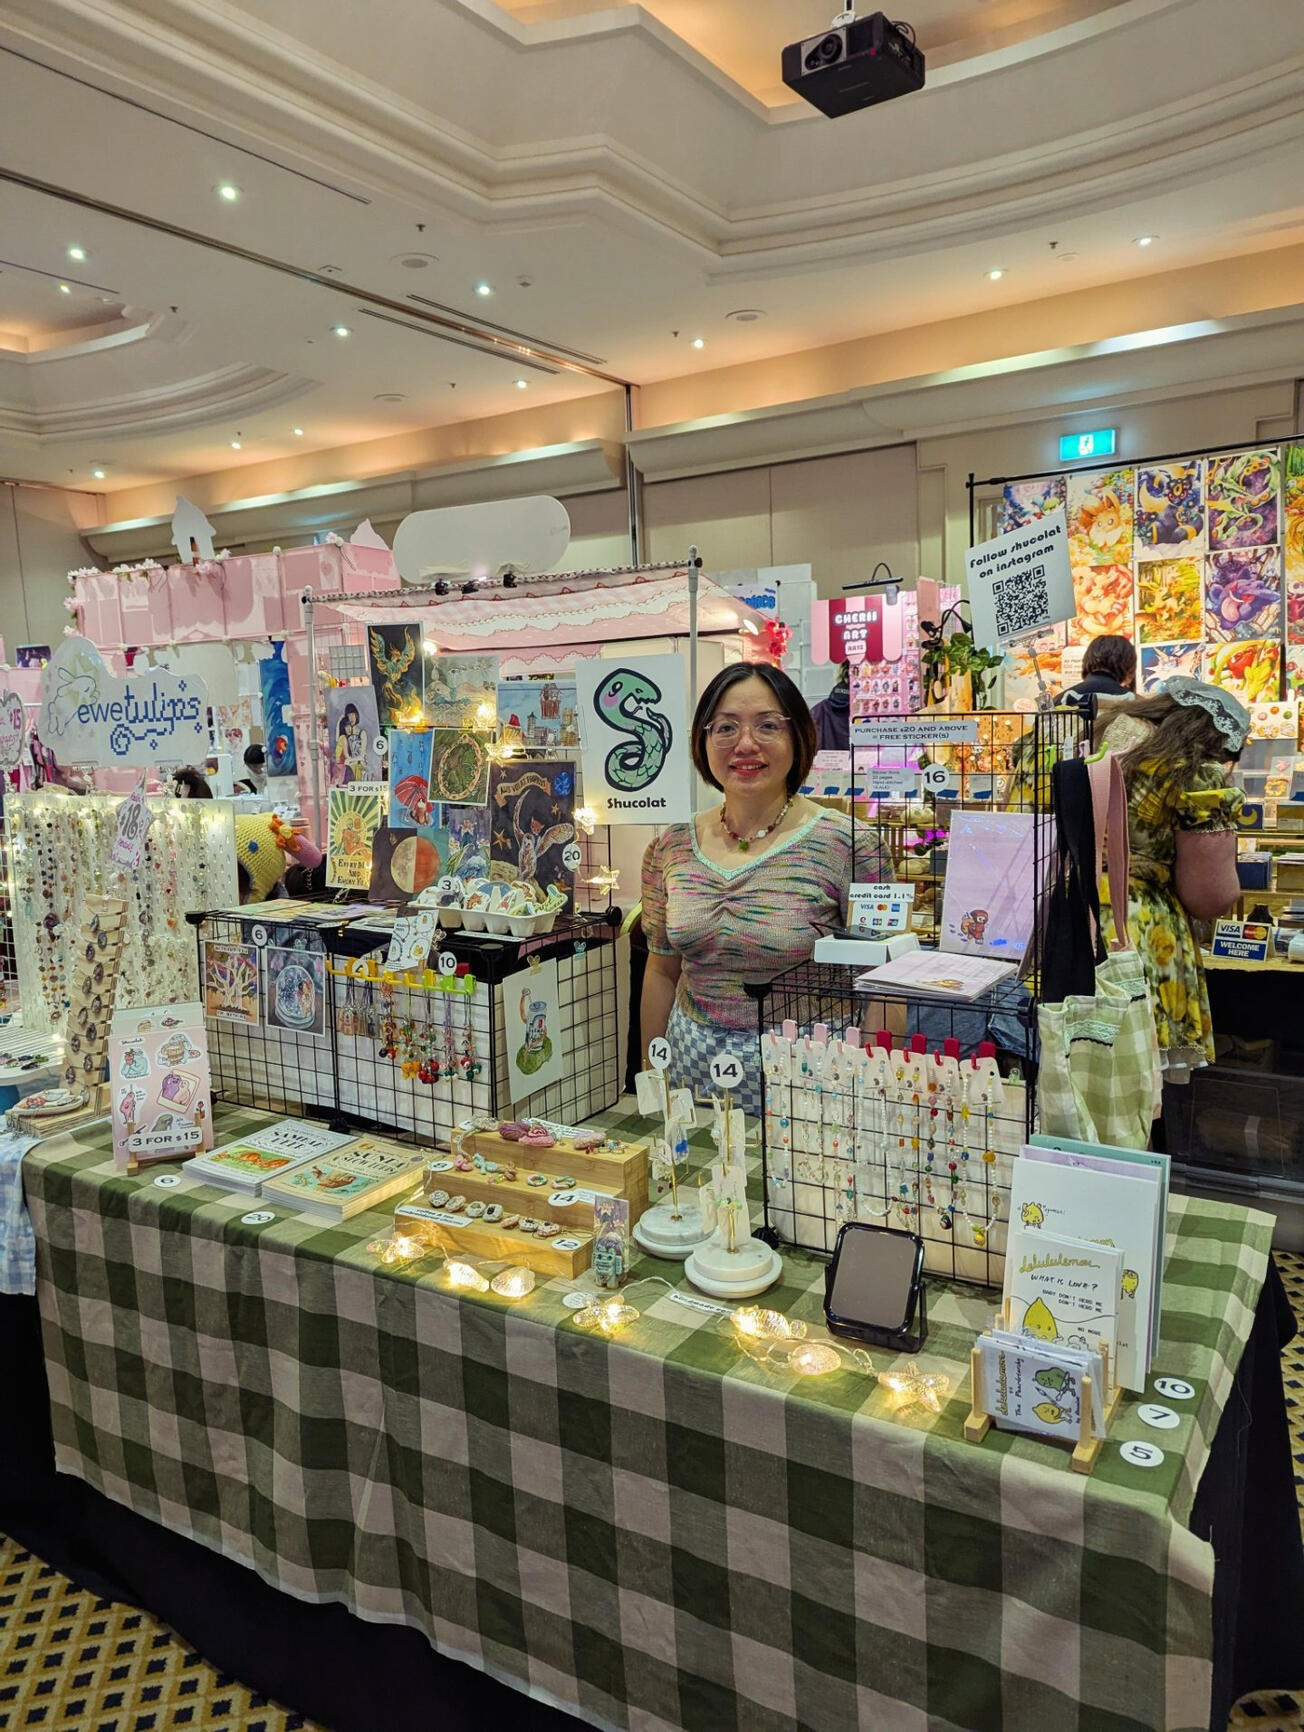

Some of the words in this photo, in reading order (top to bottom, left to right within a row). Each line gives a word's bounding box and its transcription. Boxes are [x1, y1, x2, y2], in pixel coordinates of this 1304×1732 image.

[970, 548, 1007, 568] Follow
[1011, 525, 1061, 553] shucolat
[979, 569, 993, 578] on
[996, 544, 1054, 572] instagram
[843, 628, 868, 641] ART
[78, 682, 201, 736] ewetulips
[902, 732, 949, 740] STICKER(S)
[376, 740, 385, 750] 6
[924, 770, 946, 783] 16
[607, 797, 667, 809] Shucolat
[564, 850, 581, 861] 20
[442, 880, 452, 890] 3
[1221, 925, 1240, 933] VISA
[255, 930, 263, 940] 6
[1220, 941, 1260, 951] WELCOME
[1228, 949, 1250, 957] HERE
[441, 957, 455, 968] 10
[652, 1043, 668, 1060] 14
[713, 1063, 738, 1078] 14
[132, 1137, 142, 1146] 3
[146, 1136, 172, 1145] FOR
[175, 1131, 200, 1141] $15
[553, 1193, 575, 1202] 14
[556, 1240, 578, 1248] 12
[1031, 1274, 1055, 1282] WHAT
[1158, 1380, 1191, 1394] 10
[1149, 1407, 1171, 1420] 7
[1129, 1445, 1153, 1460] 5
